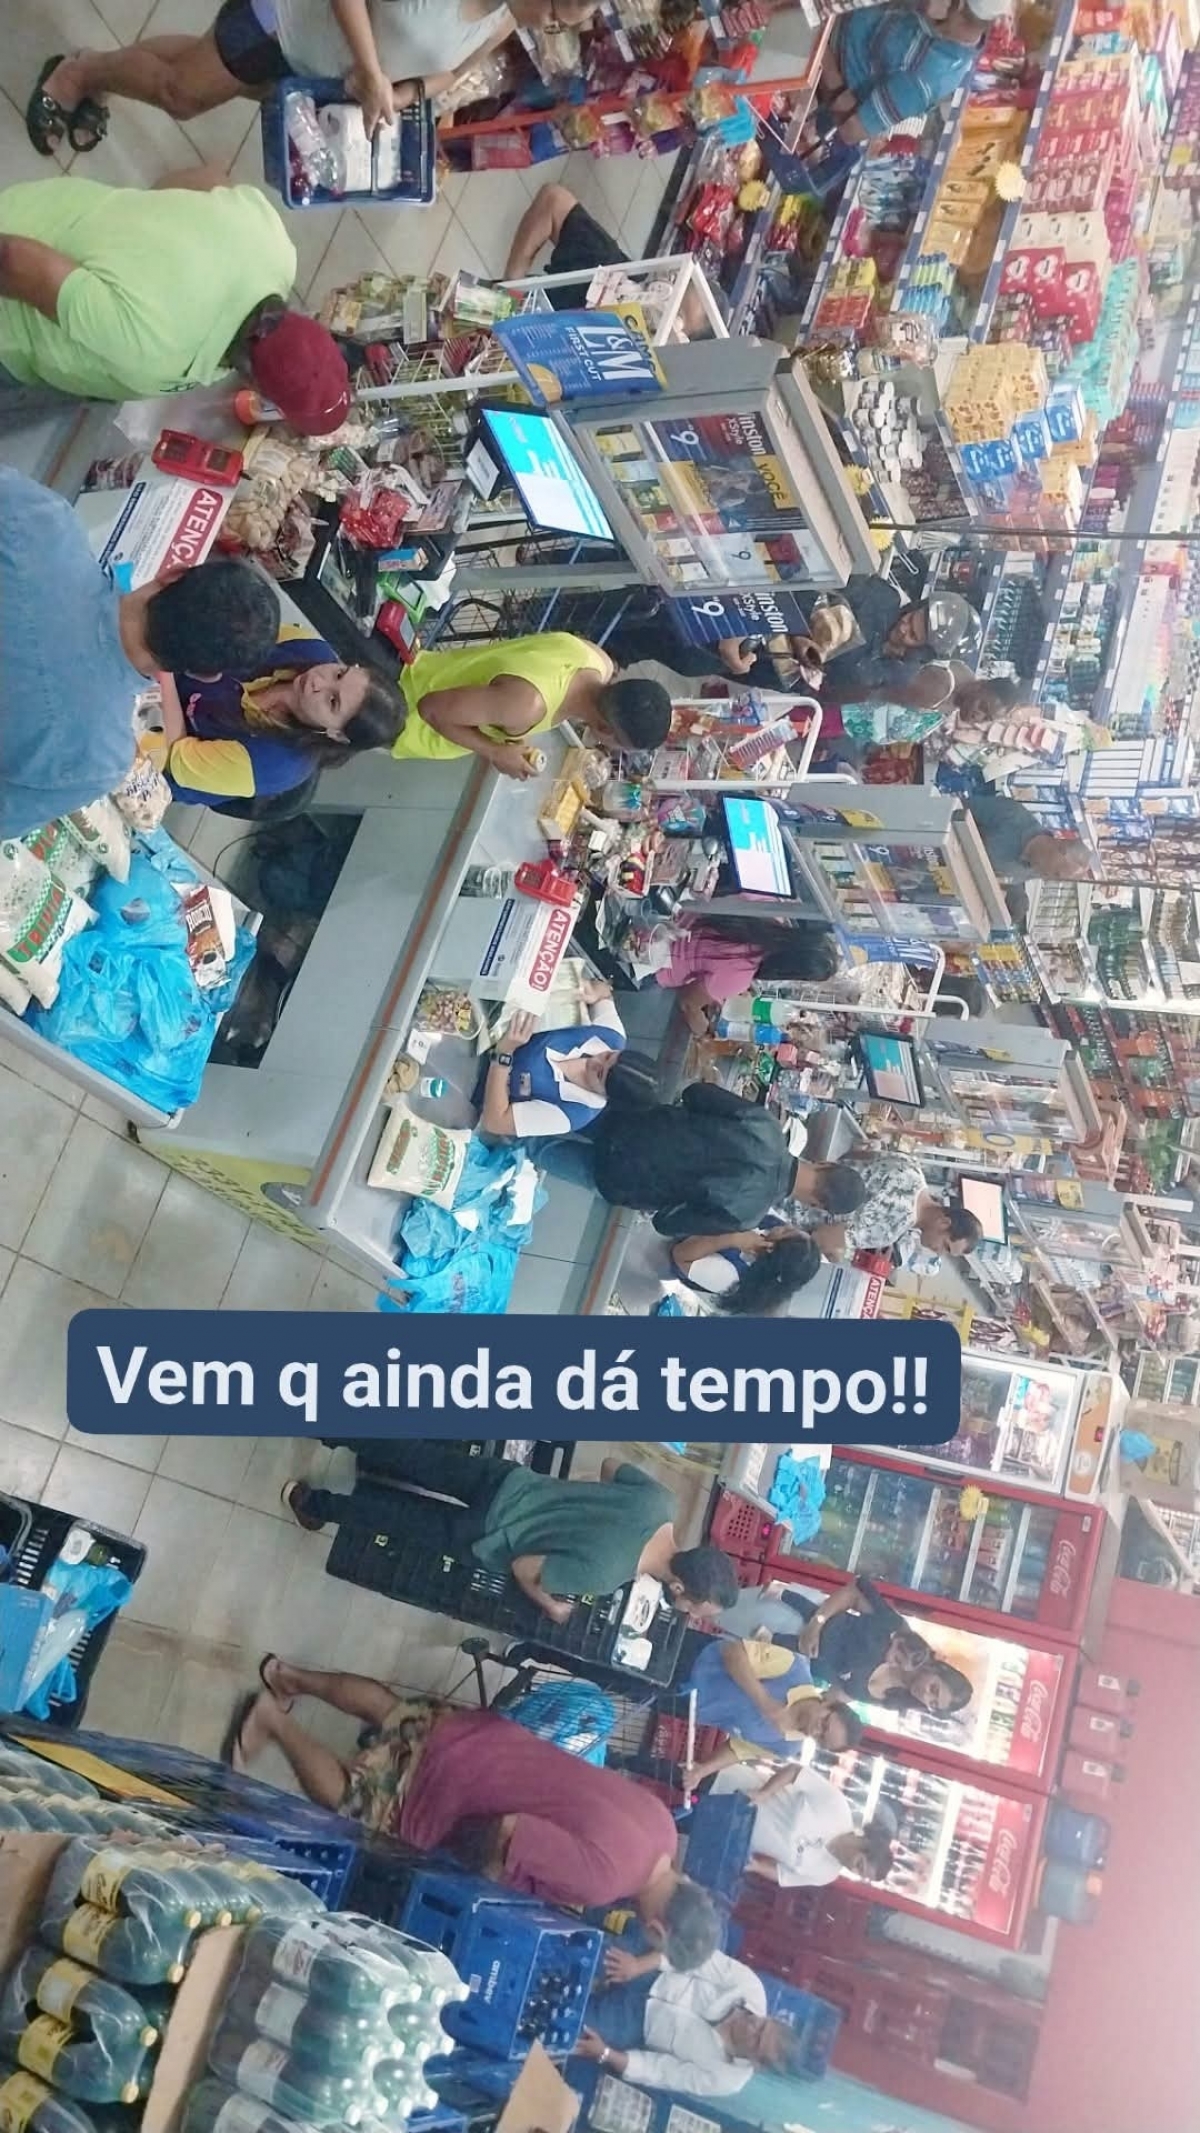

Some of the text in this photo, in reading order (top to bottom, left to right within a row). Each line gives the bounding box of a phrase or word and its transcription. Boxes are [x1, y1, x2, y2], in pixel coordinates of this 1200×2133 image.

[564, 326, 602, 381] FIRST CUT
[576, 326, 654, 380] L&M
[670, 430, 699, 446] 9
[737, 412, 767, 455] inston
[690, 600, 724, 616] 9
[755, 592, 789, 633] inston
[530, 910, 568, 990] ATENÇÃO!
[483, 1960, 502, 2006] ambev
